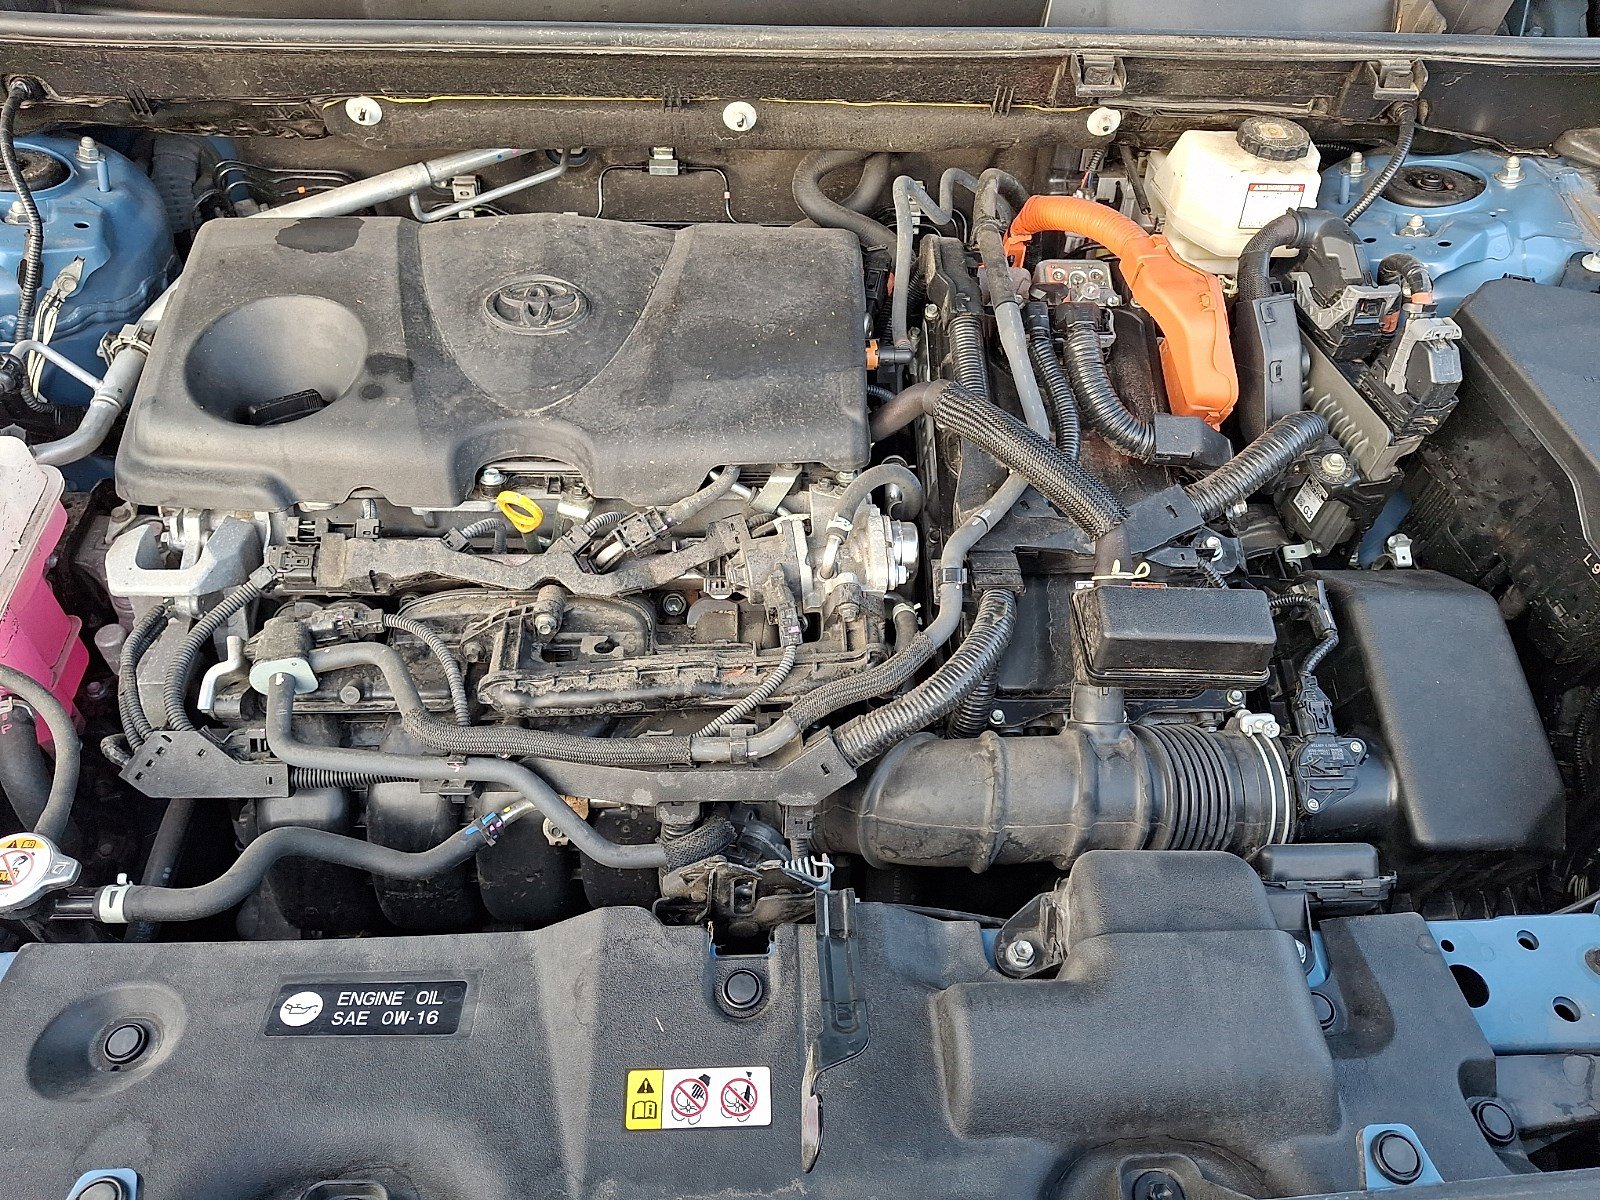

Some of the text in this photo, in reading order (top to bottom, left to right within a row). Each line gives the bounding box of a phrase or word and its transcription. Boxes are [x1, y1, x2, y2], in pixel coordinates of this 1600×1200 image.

[1303, 505, 1313, 519] G3
[336, 990, 443, 1006] ENGINE OIL
[331, 1010, 440, 1025] SAE 0W-16
